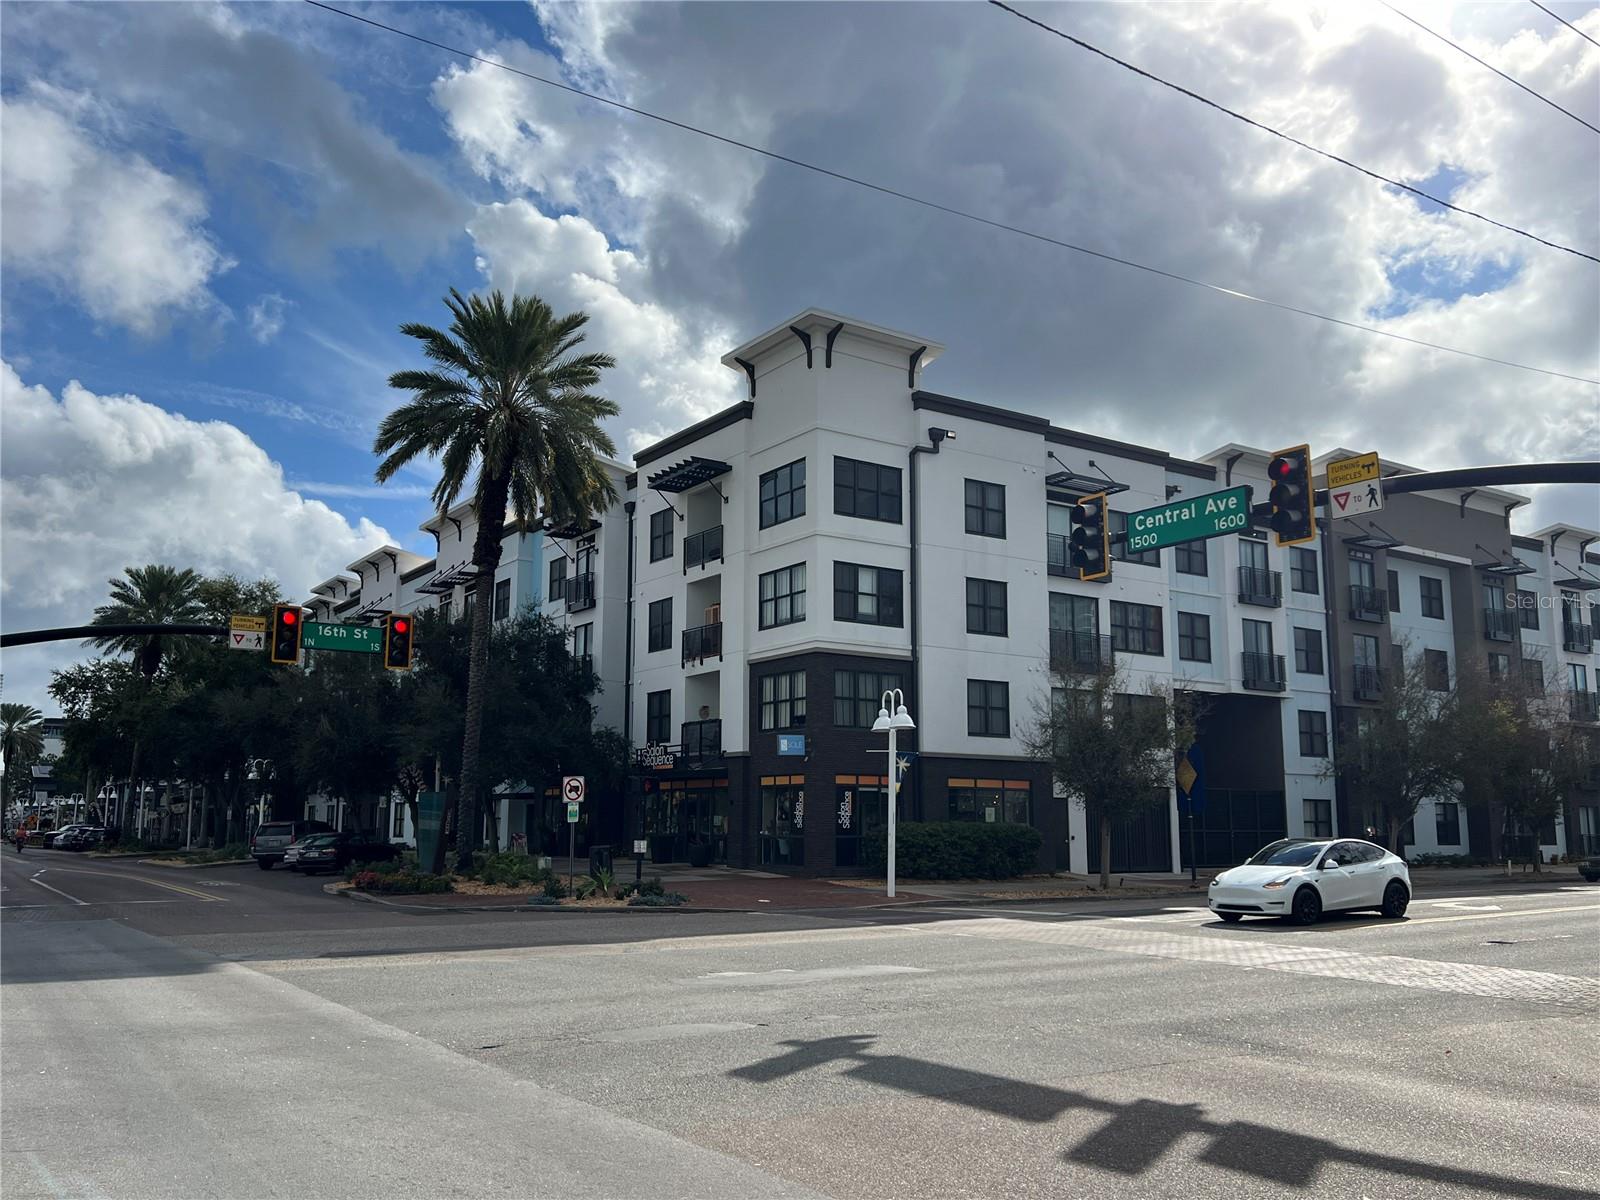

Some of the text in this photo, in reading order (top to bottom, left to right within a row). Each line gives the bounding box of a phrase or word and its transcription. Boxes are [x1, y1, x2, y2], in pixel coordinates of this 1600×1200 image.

[1331, 460, 1360, 473] TURNING
[1331, 471, 1362, 484] VEHICLES
[1353, 494, 1362, 503] TO
[1135, 496, 1238, 531] Central Ave
[1214, 513, 1245, 530] 1600
[1130, 533, 1158, 549] 1500
[318, 625, 368, 639] 16th St
[304, 637, 315, 646] 1N
[370, 642, 380, 651] 1S
[646, 740, 665, 757] Salon
[642, 753, 674, 770] Sequence
[837, 802, 846, 824] Salon
[842, 791, 851, 829] Sequence
